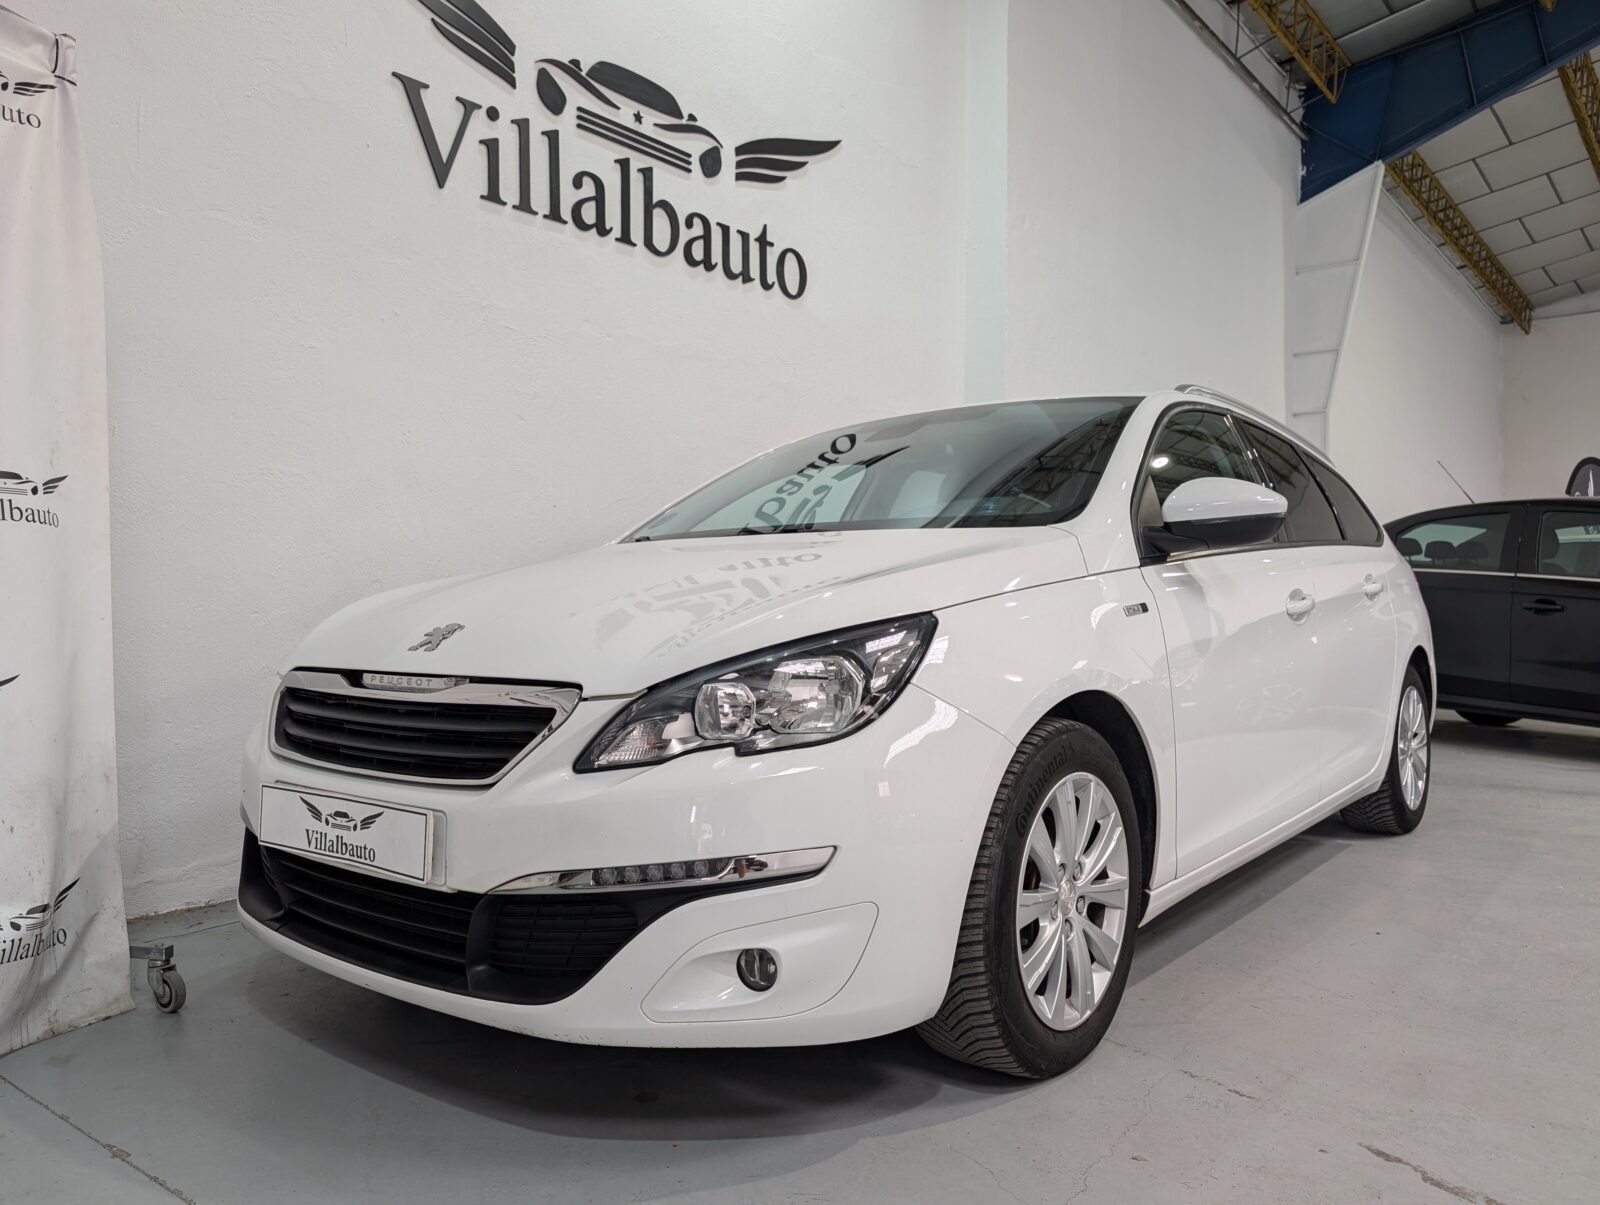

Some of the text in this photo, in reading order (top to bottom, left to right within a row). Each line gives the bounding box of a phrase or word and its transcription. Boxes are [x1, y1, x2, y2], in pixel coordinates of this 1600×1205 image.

[391, 71, 808, 300] Villalbauto
[370, 675, 434, 687] PEUGEOT
[1015, 744, 1068, 839] Continental
[304, 828, 376, 863] Villalbauto
